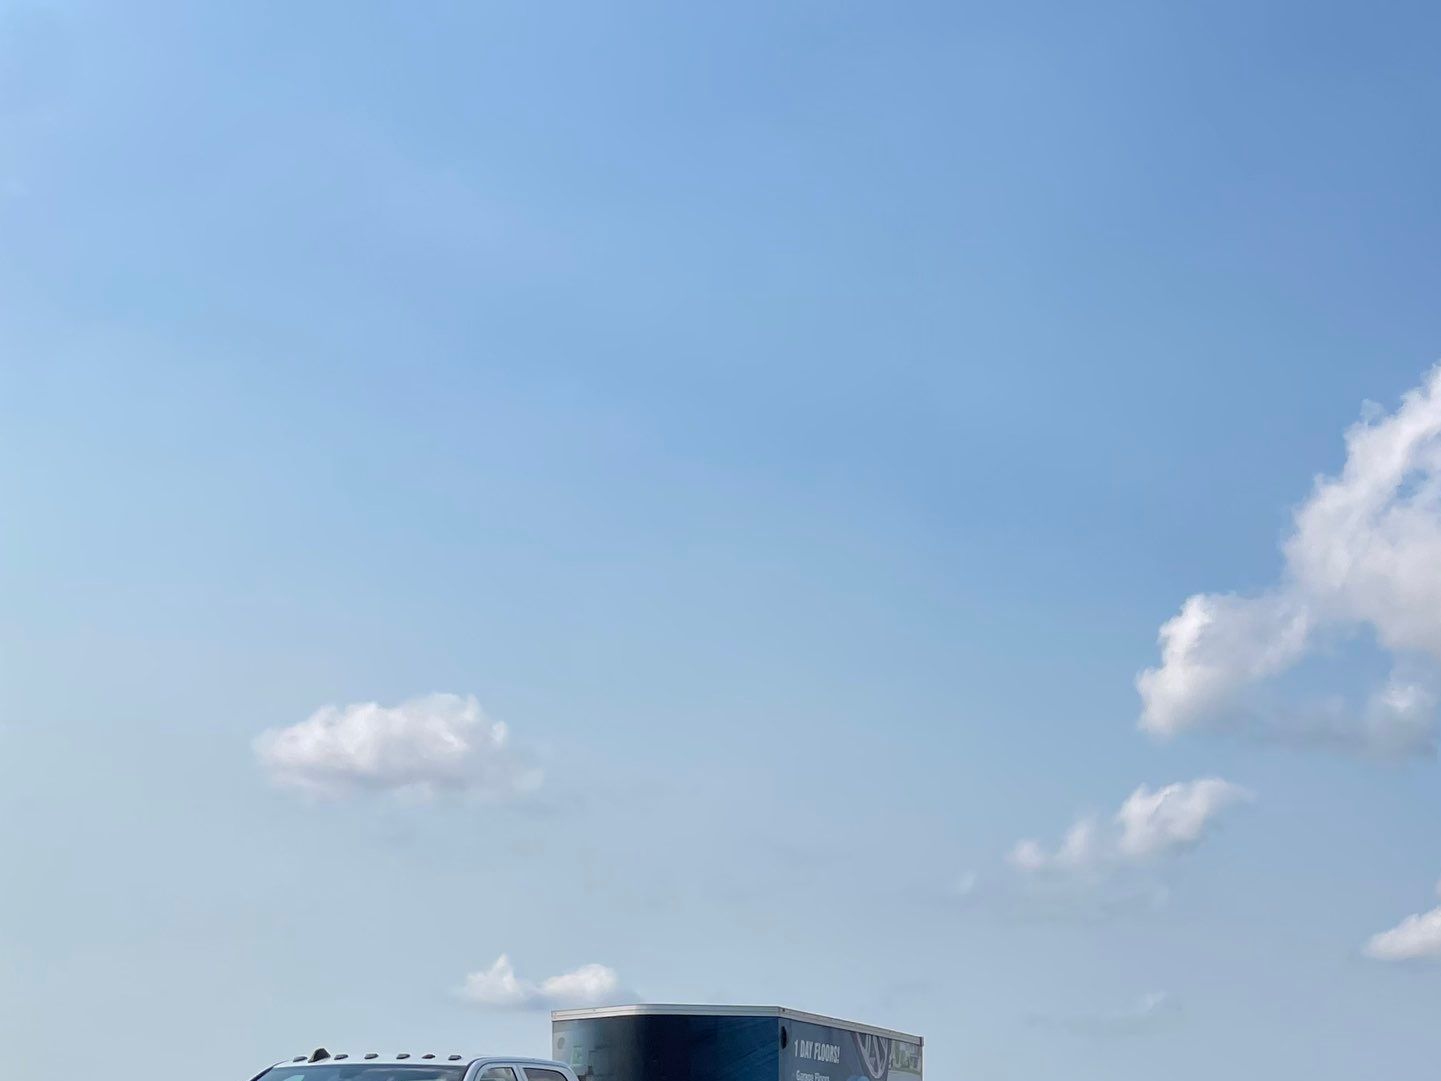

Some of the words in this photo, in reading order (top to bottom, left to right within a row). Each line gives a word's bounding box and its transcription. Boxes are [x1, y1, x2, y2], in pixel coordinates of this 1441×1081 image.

[794, 1040, 799, 1057] 1
[800, 1040, 813, 1059] DAY
[814, 1043, 840, 1064] FLOORS!
